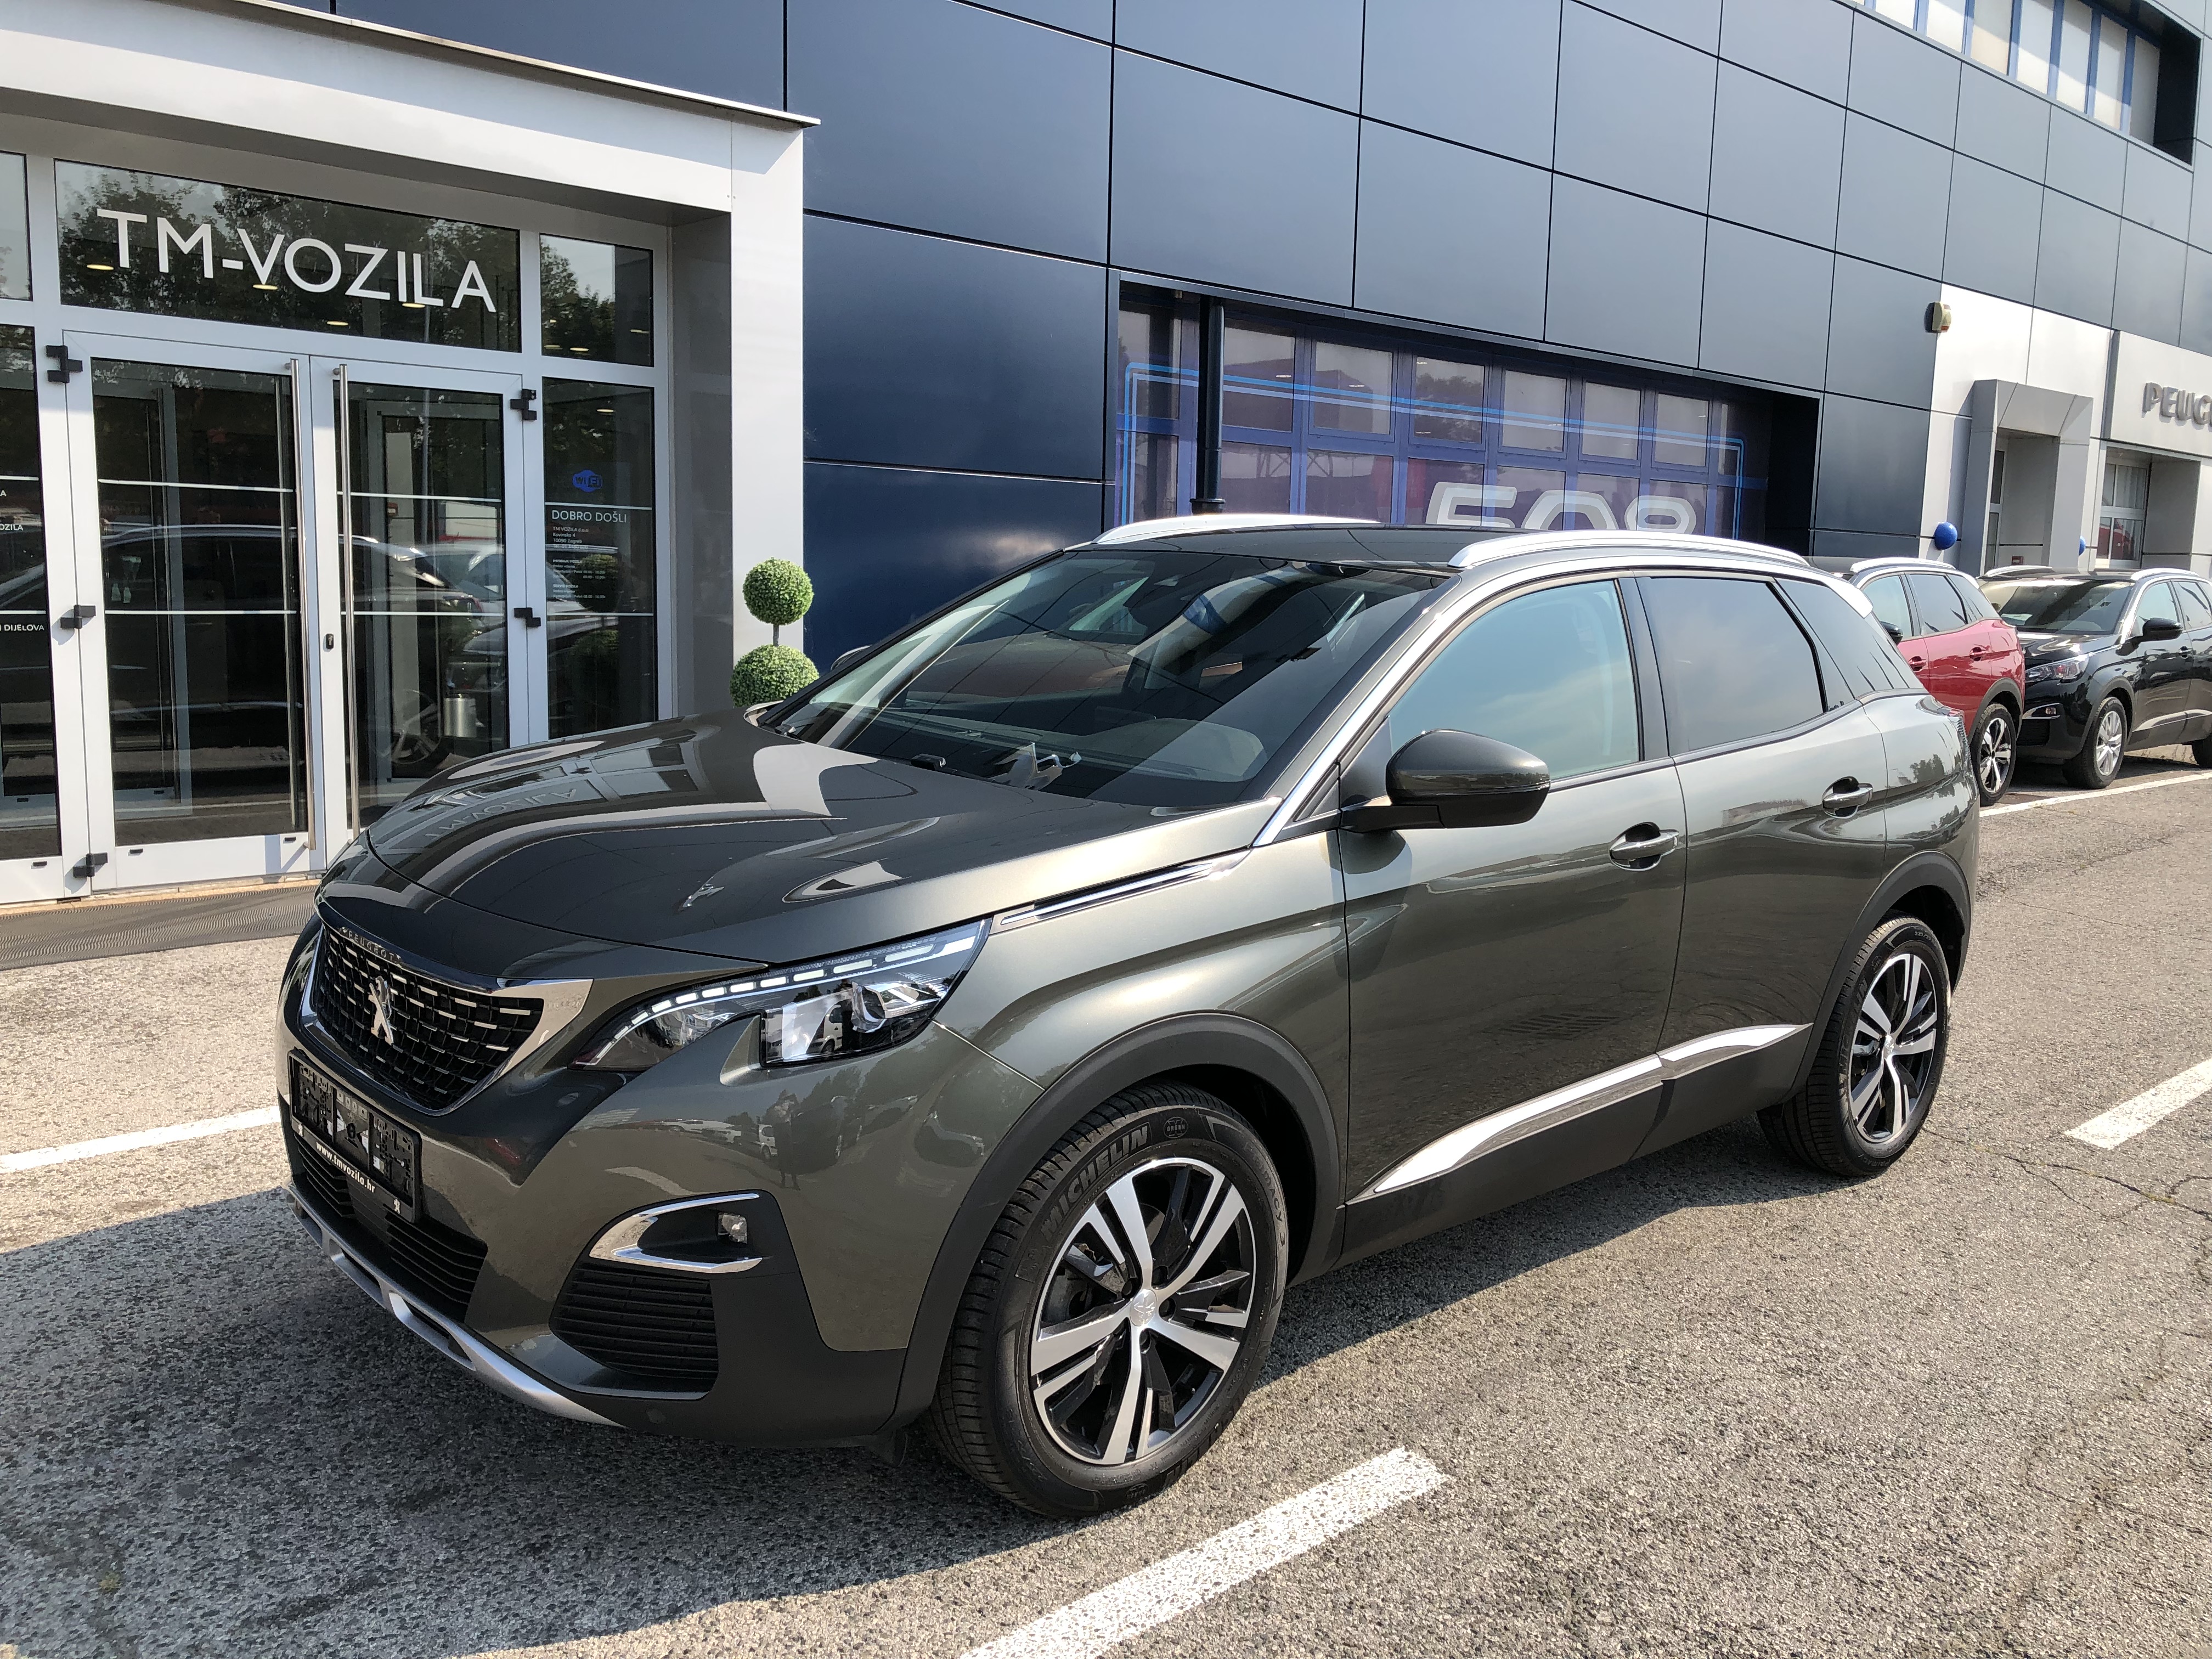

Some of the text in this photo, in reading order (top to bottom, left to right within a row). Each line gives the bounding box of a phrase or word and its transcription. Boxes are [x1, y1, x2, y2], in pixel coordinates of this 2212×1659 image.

[97, 208, 497, 313] TM-VOZILA
[2141, 382, 2212, 426] PEUG
[552, 510, 627, 523] DOBRO DOŠLI
[348, 929, 394, 961] PEUGEOT
[315, 1141, 376, 1193] www.tmvozila.hr
[1040, 1125, 1148, 1242] MICHELIN
